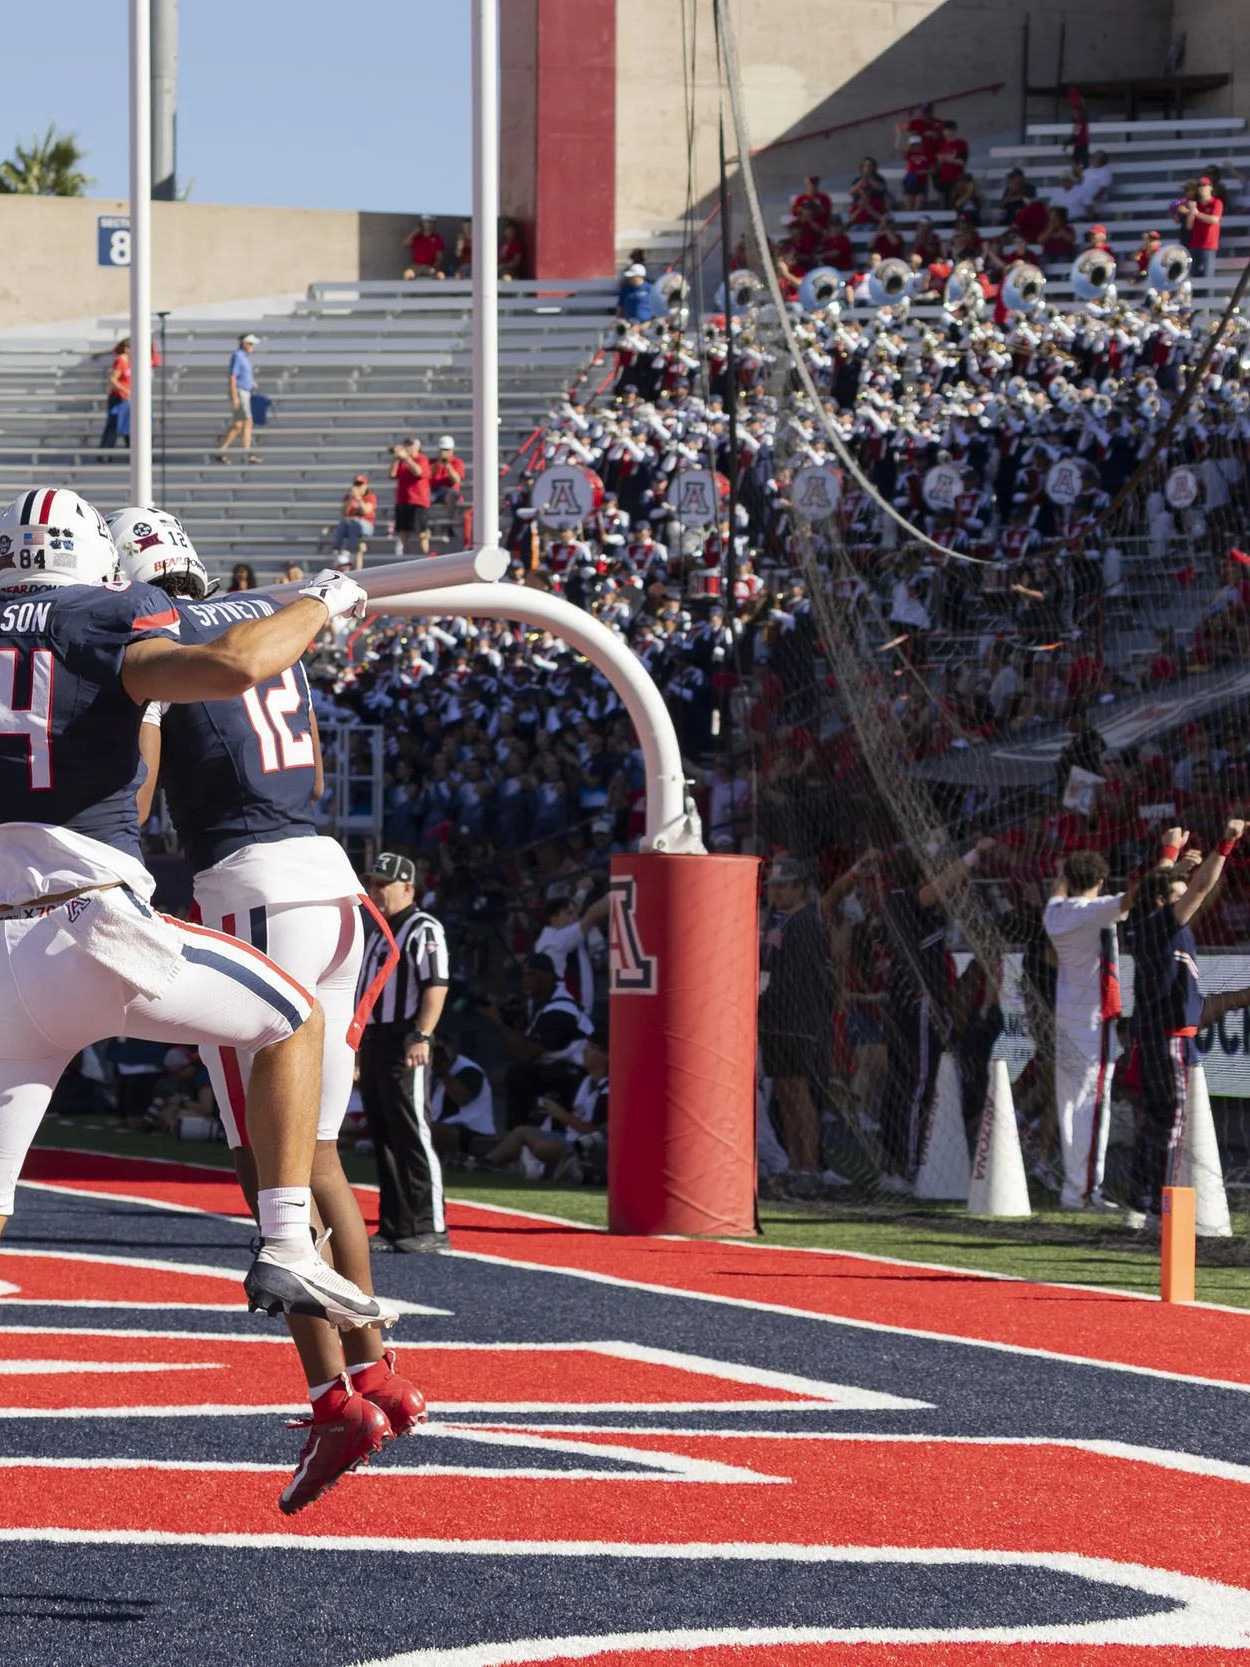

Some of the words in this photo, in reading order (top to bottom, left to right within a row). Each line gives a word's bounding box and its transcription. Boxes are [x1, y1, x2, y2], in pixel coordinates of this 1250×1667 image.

[110, 231, 131, 265] 8
[168, 531, 188, 548] 12
[19, 549, 45, 569] 84
[187, 601, 261, 627] SPIVEY
[242, 667, 316, 774] 12
